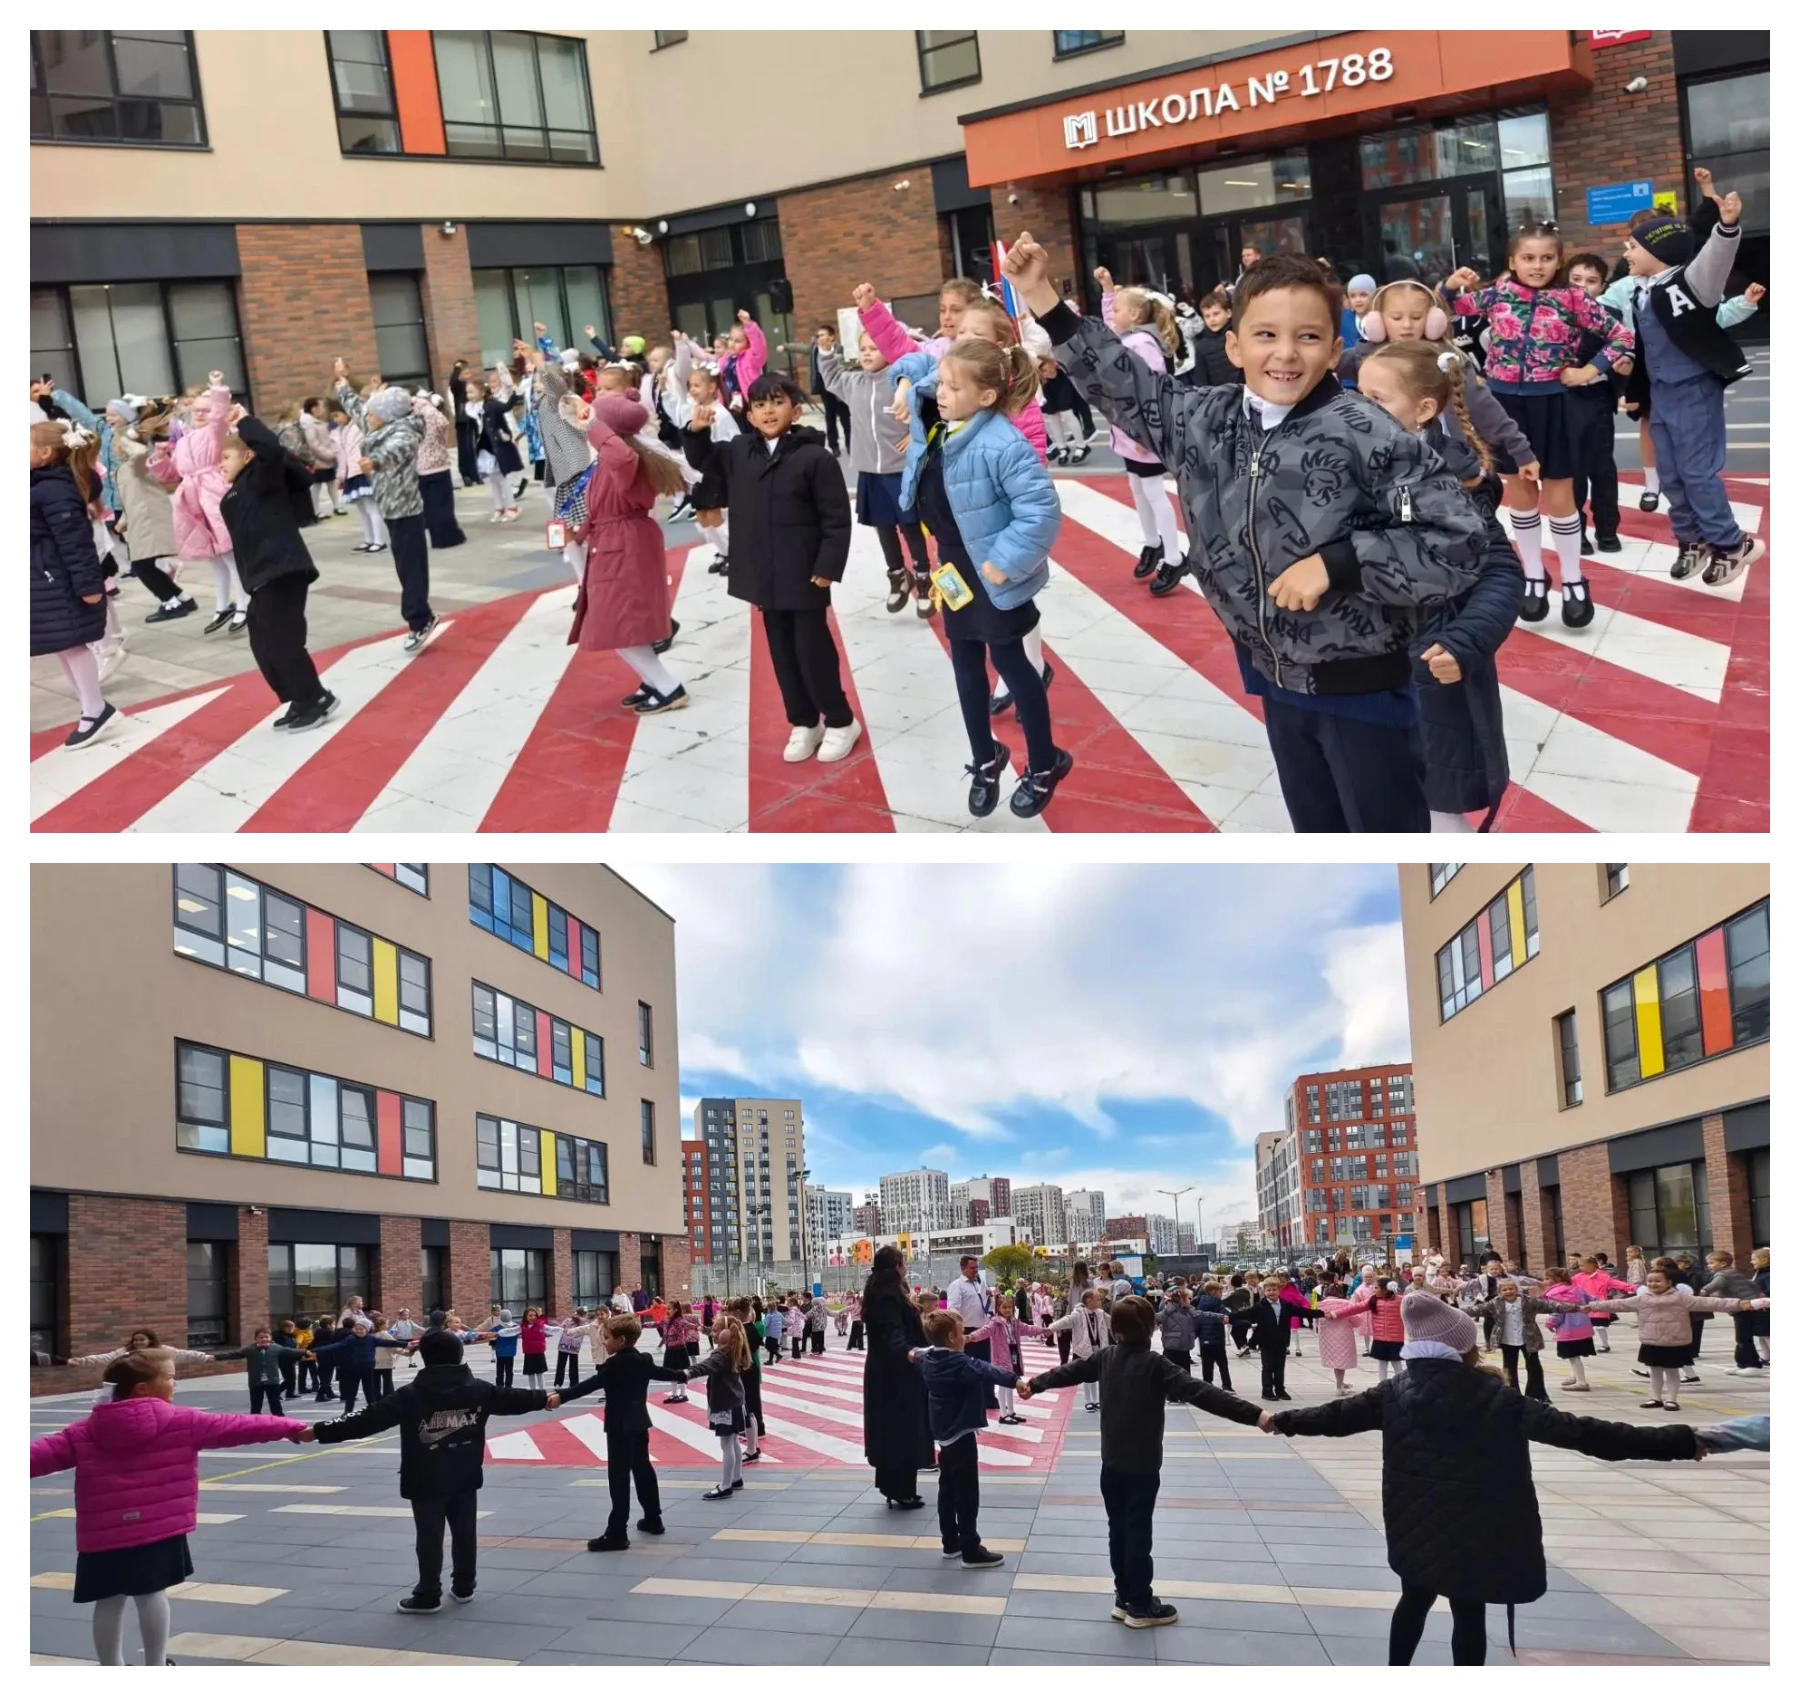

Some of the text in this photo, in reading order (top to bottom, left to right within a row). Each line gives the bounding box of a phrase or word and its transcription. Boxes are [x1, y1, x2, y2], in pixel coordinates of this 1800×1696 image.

[1106, 47, 1394, 137] ШКОЛА № 1788
[1665, 284, 1696, 318] A
